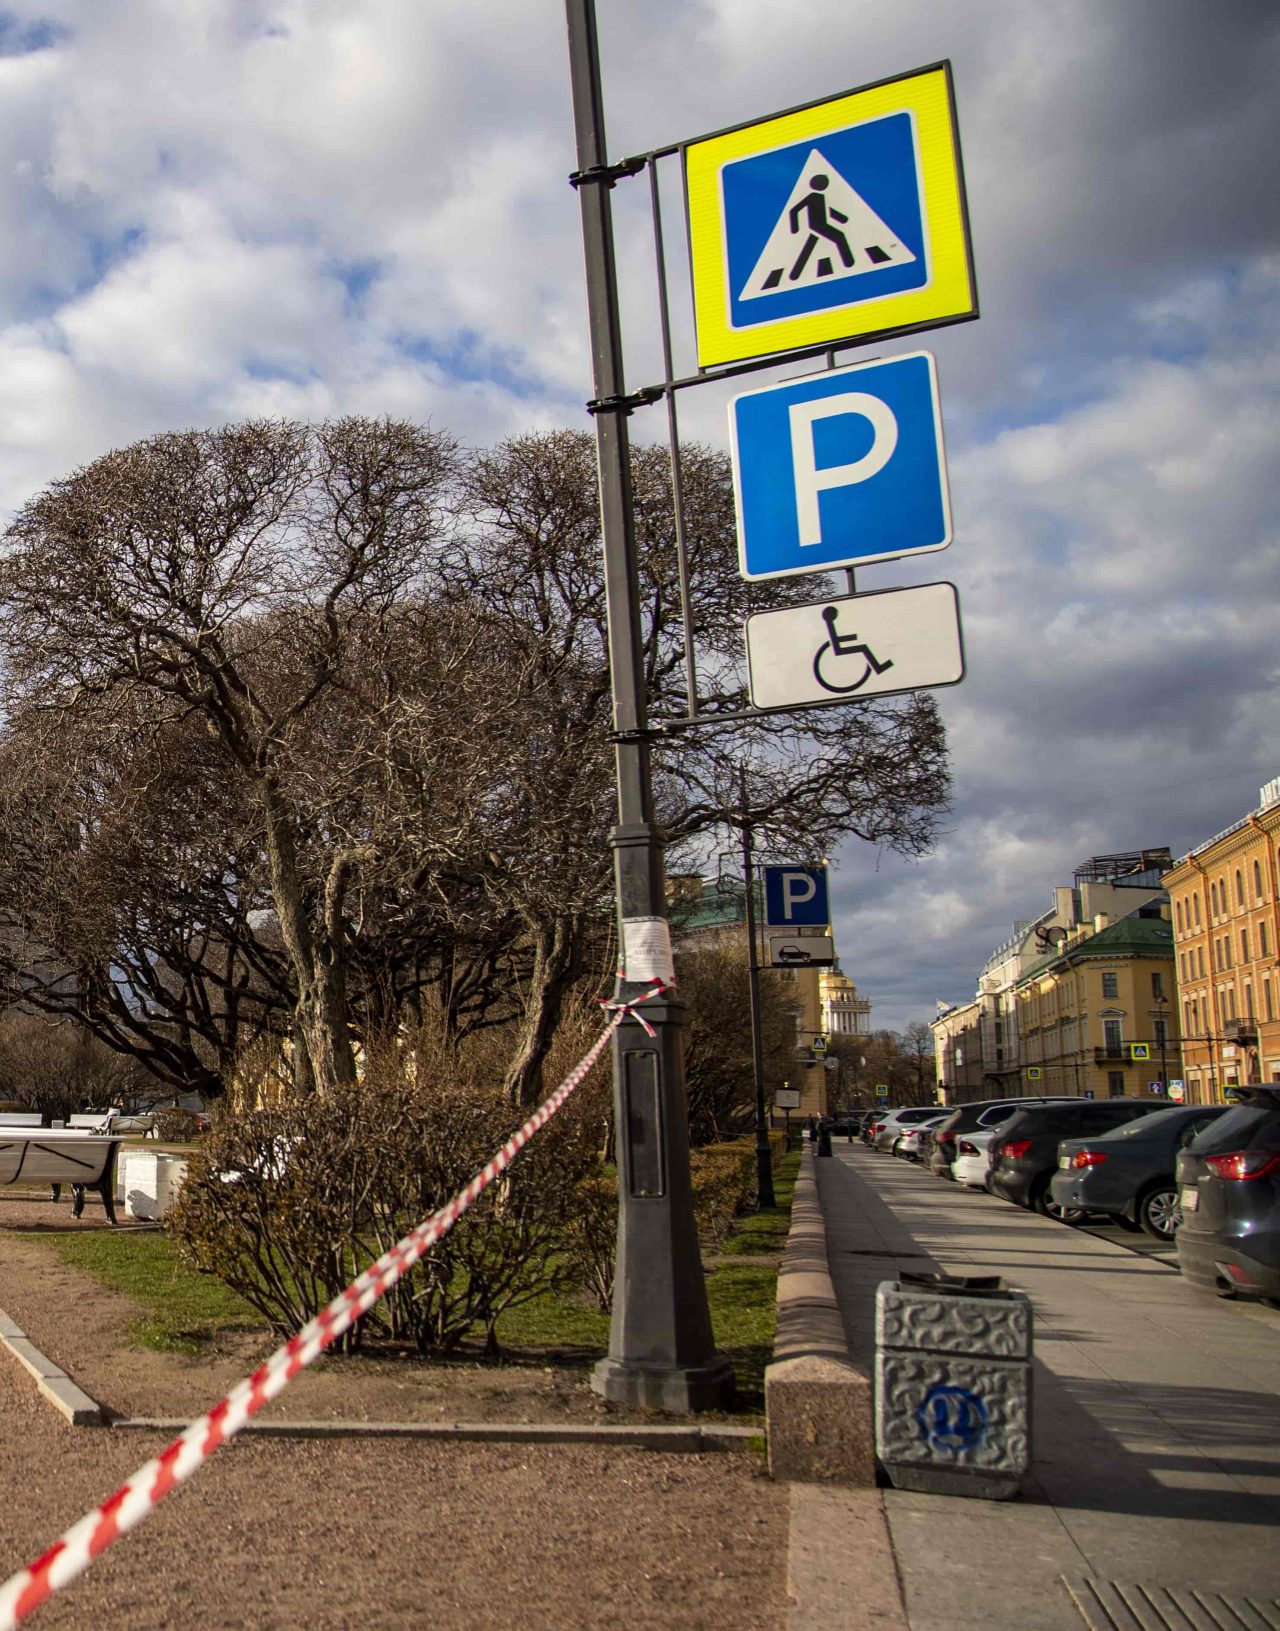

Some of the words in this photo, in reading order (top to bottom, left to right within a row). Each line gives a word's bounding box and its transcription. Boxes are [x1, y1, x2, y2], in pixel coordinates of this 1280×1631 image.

[788, 391, 898, 547] P
[782, 872, 816, 920] P
[1035, 926, 1068, 947] SO
